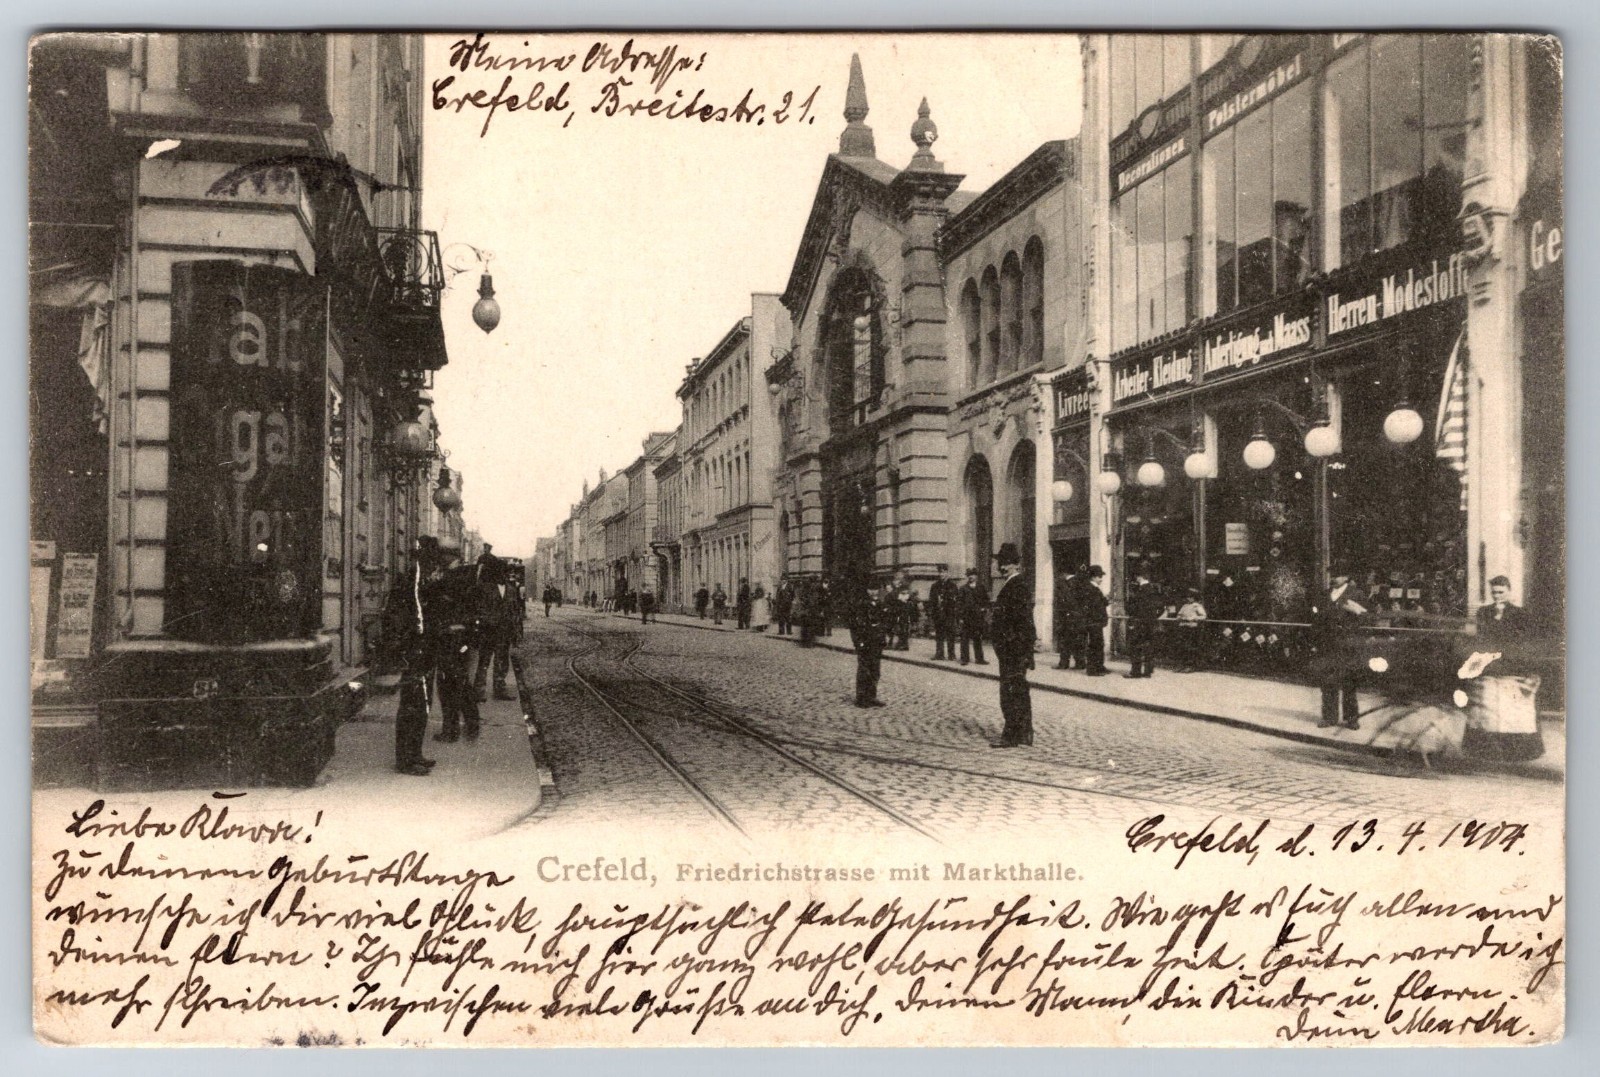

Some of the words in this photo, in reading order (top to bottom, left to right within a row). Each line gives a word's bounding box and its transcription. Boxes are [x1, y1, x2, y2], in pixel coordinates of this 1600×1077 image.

[449, 33, 576, 73] Meine
[432, 75, 575, 138] Crefeld,
[1125, 814, 1270, 870] Crefeld,
